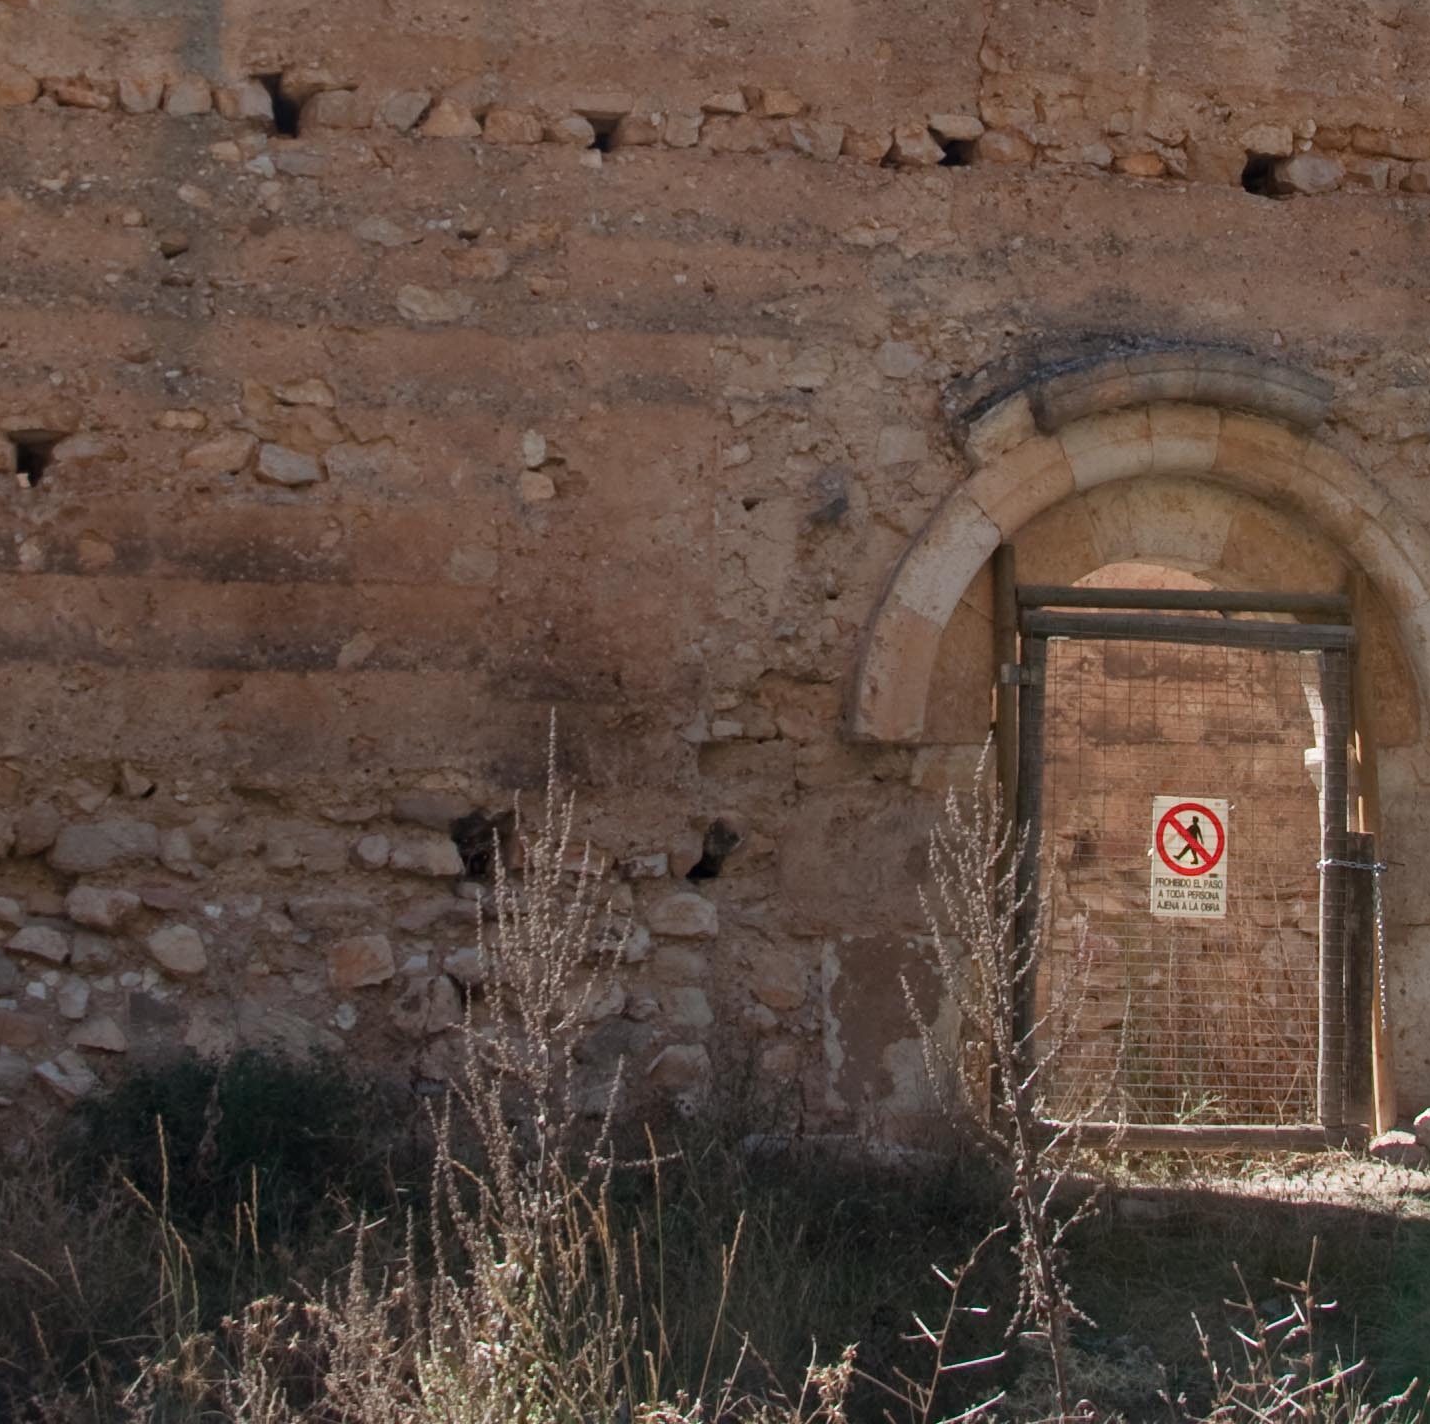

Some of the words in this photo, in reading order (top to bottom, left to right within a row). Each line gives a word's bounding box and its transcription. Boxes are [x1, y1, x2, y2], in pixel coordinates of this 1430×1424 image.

[1155, 877, 1191, 888] PROHIBIDO
[1193, 879, 1202, 888] EL
[1203, 879, 1223, 889] PASO
[1158, 889, 1163, 898] A
[1166, 889, 1185, 898] TODA
[1187, 890, 1219, 900] PERSONA
[1157, 900, 1179, 910] AJENA
[1181, 901, 1187, 910] A
[1188, 901, 1198, 911] LA
[1200, 902, 1220, 912] OBRA
